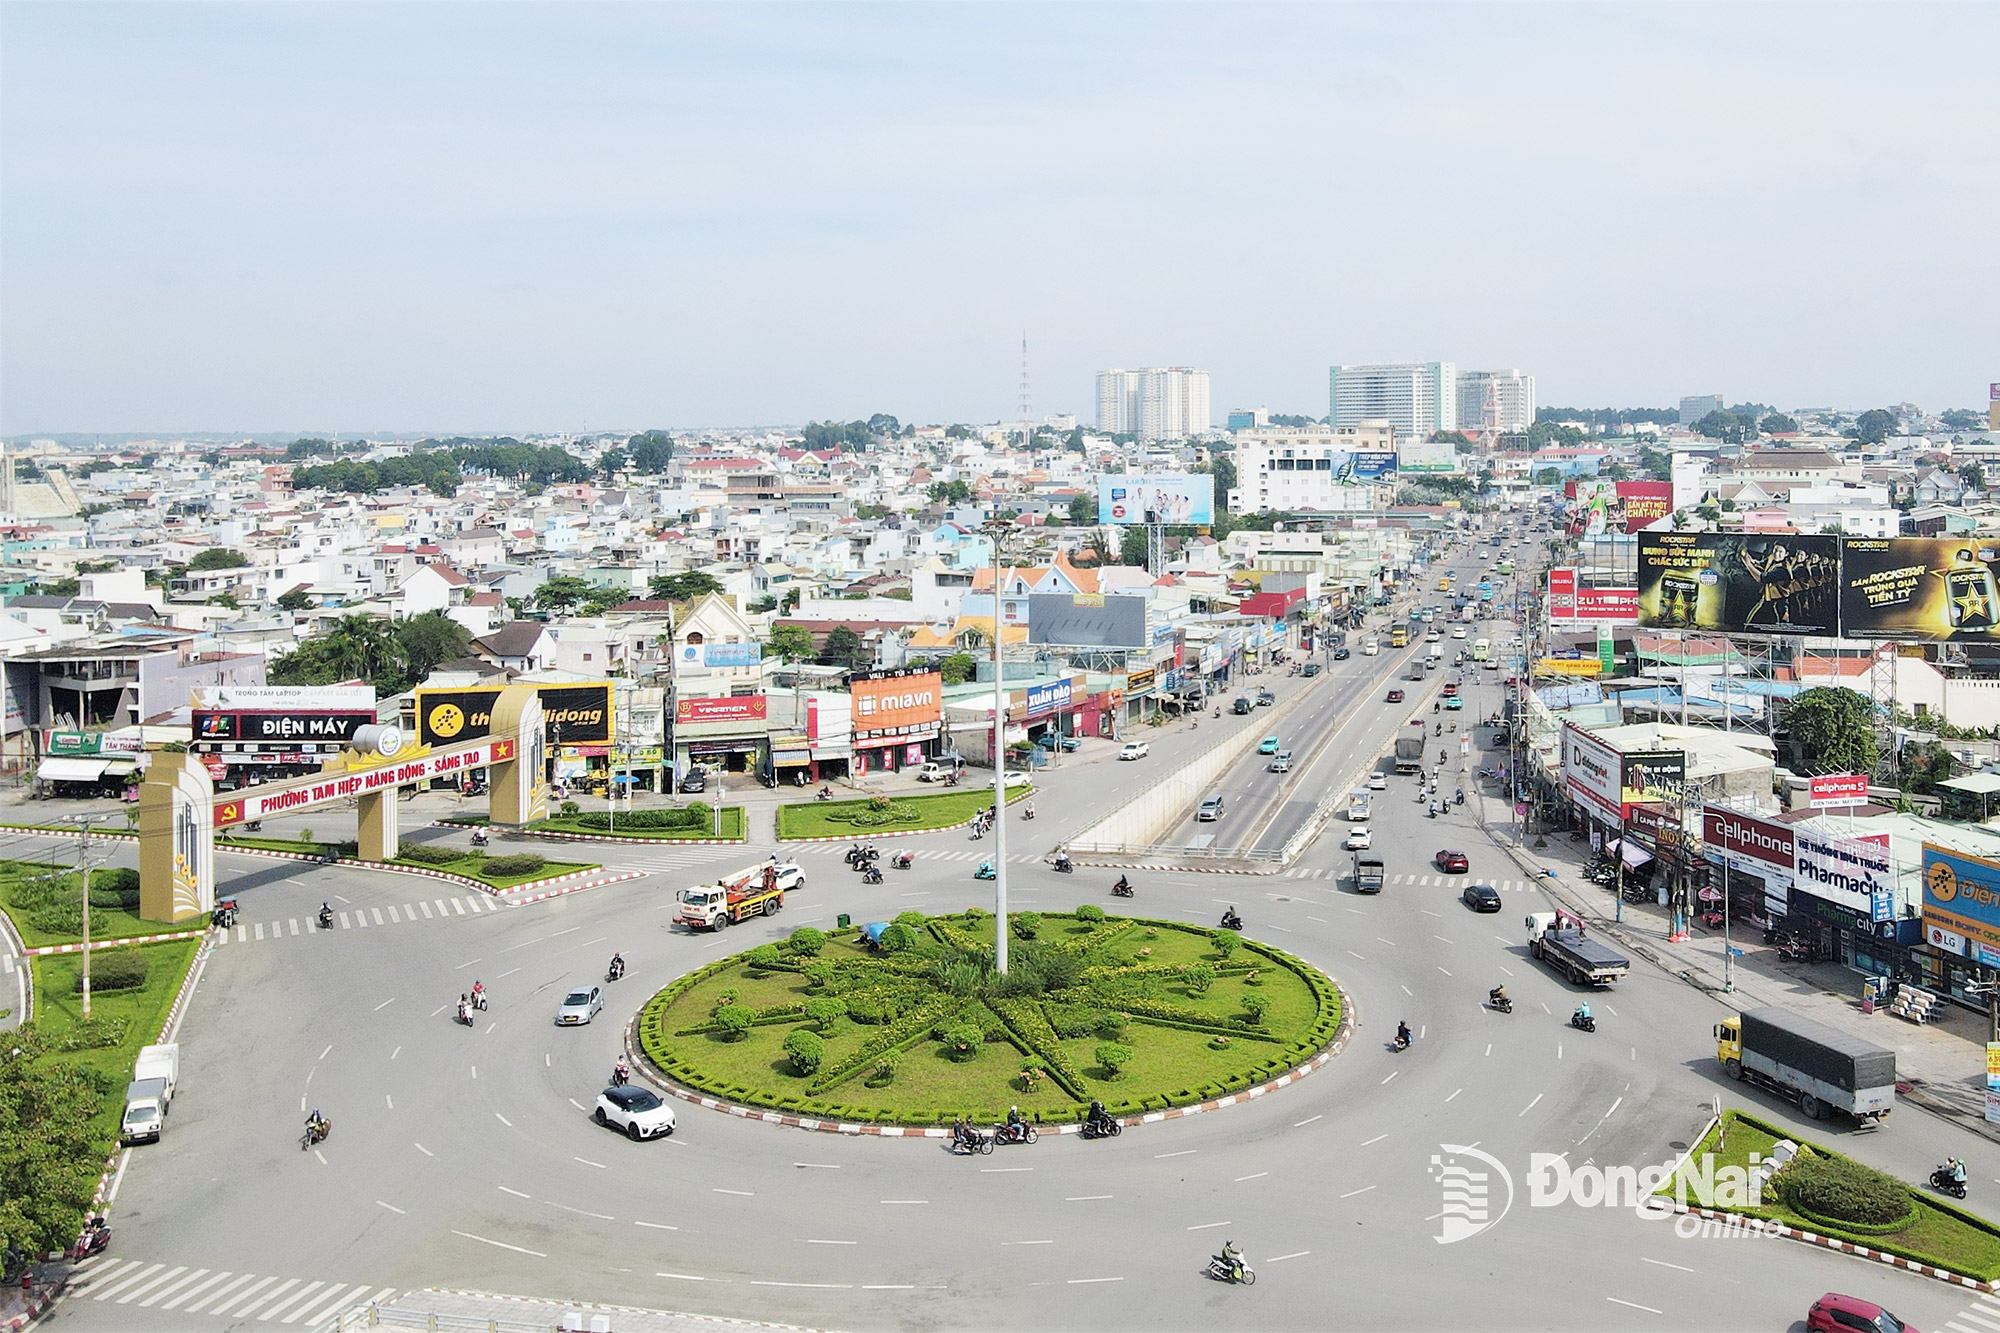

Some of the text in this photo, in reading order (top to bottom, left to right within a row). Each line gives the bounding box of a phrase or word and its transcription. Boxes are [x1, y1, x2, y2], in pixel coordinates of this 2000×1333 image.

[1847, 540, 1889, 549] ROCKSTAR
[1869, 565, 1926, 584] ROCKSTAR
[1664, 580, 1696, 589] ROCKSTAR
[881, 691, 932, 711] mia.vn
[1028, 689, 1052, 707] XUÂN
[698, 705, 747, 713] VINAMEN
[262, 717, 304, 738] ĐIỆN
[309, 717, 349, 734] MÁY
[261, 788, 308, 813] PHƯỜNG
[312, 784, 335, 801] TAM
[338, 776, 362, 795] HIỆP
[365, 768, 394, 788] NĂNG
[397, 764, 425, 784] ĐỘNG
[435, 754, 460, 776] SÁNG
[461, 750, 480, 767] TẠO
[1810, 843, 1838, 859] THỐNG
[1960, 879, 2000, 908] Điện
[1817, 903, 1877, 936] Pharmacity
[1955, 920, 1981, 934] SONY
[1943, 935, 1956, 948] LG
